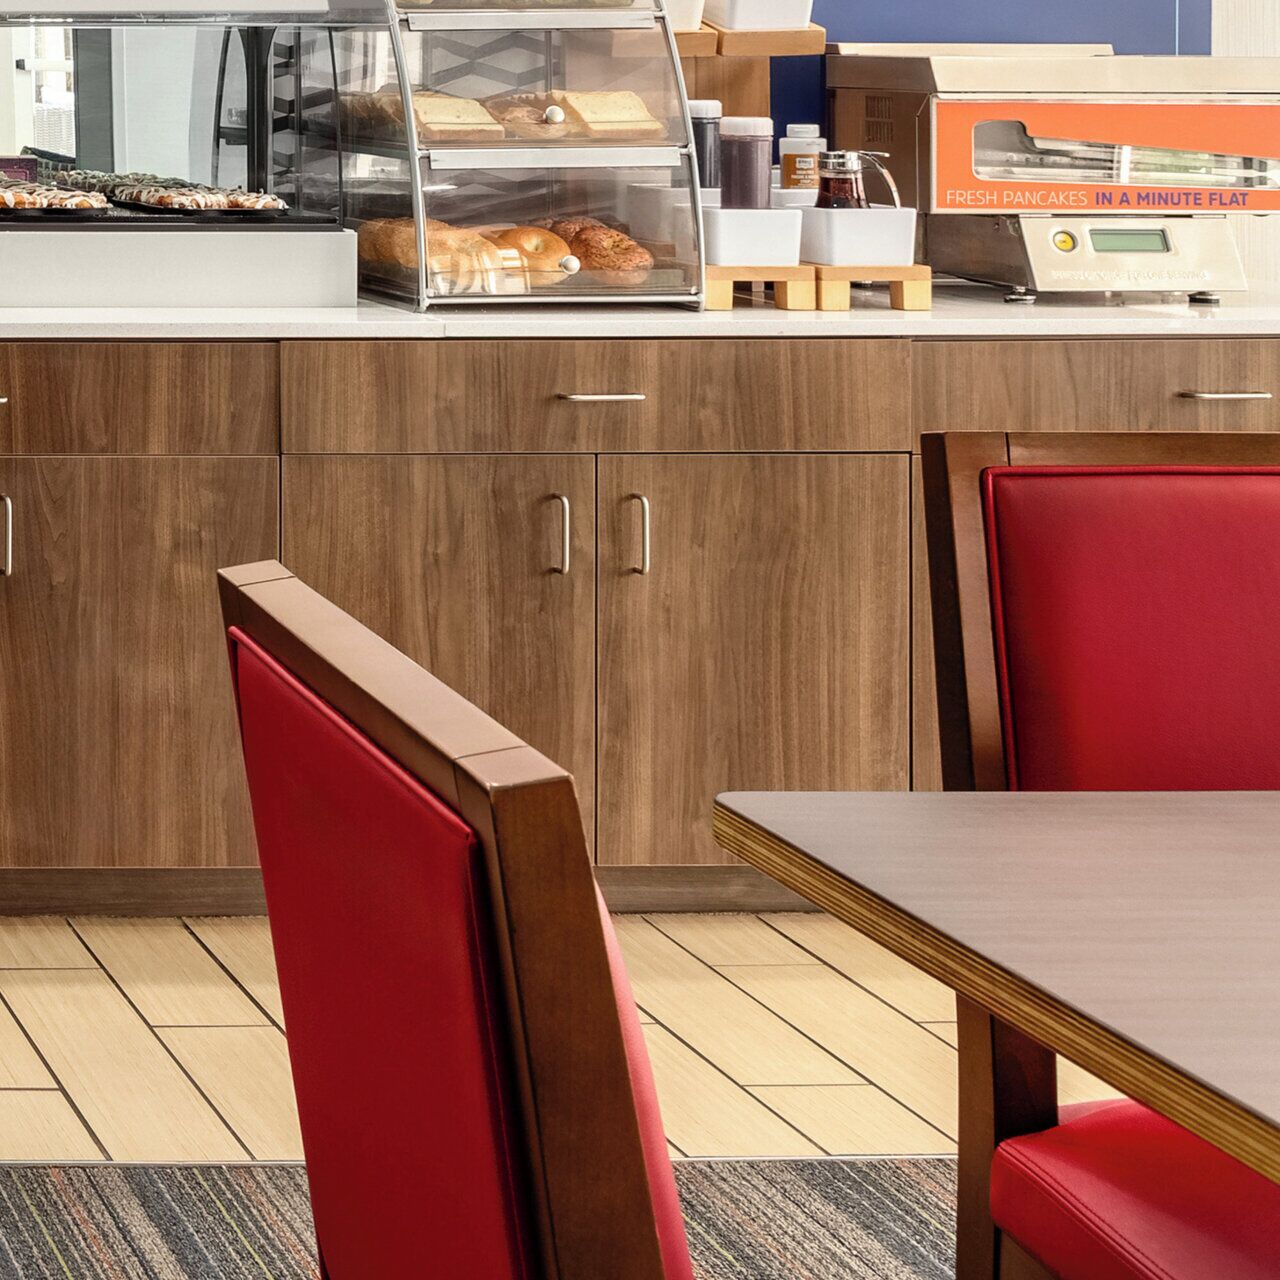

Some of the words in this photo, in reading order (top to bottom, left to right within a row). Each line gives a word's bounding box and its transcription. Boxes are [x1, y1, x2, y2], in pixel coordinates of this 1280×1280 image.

[946, 190, 997, 205] FRESH
[1003, 190, 1087, 206] PANCAKES
[1095, 192, 1114, 206] IN
[1119, 192, 1132, 206] A
[1137, 192, 1202, 206] MINUTE
[1209, 192, 1249, 207] FLAT
